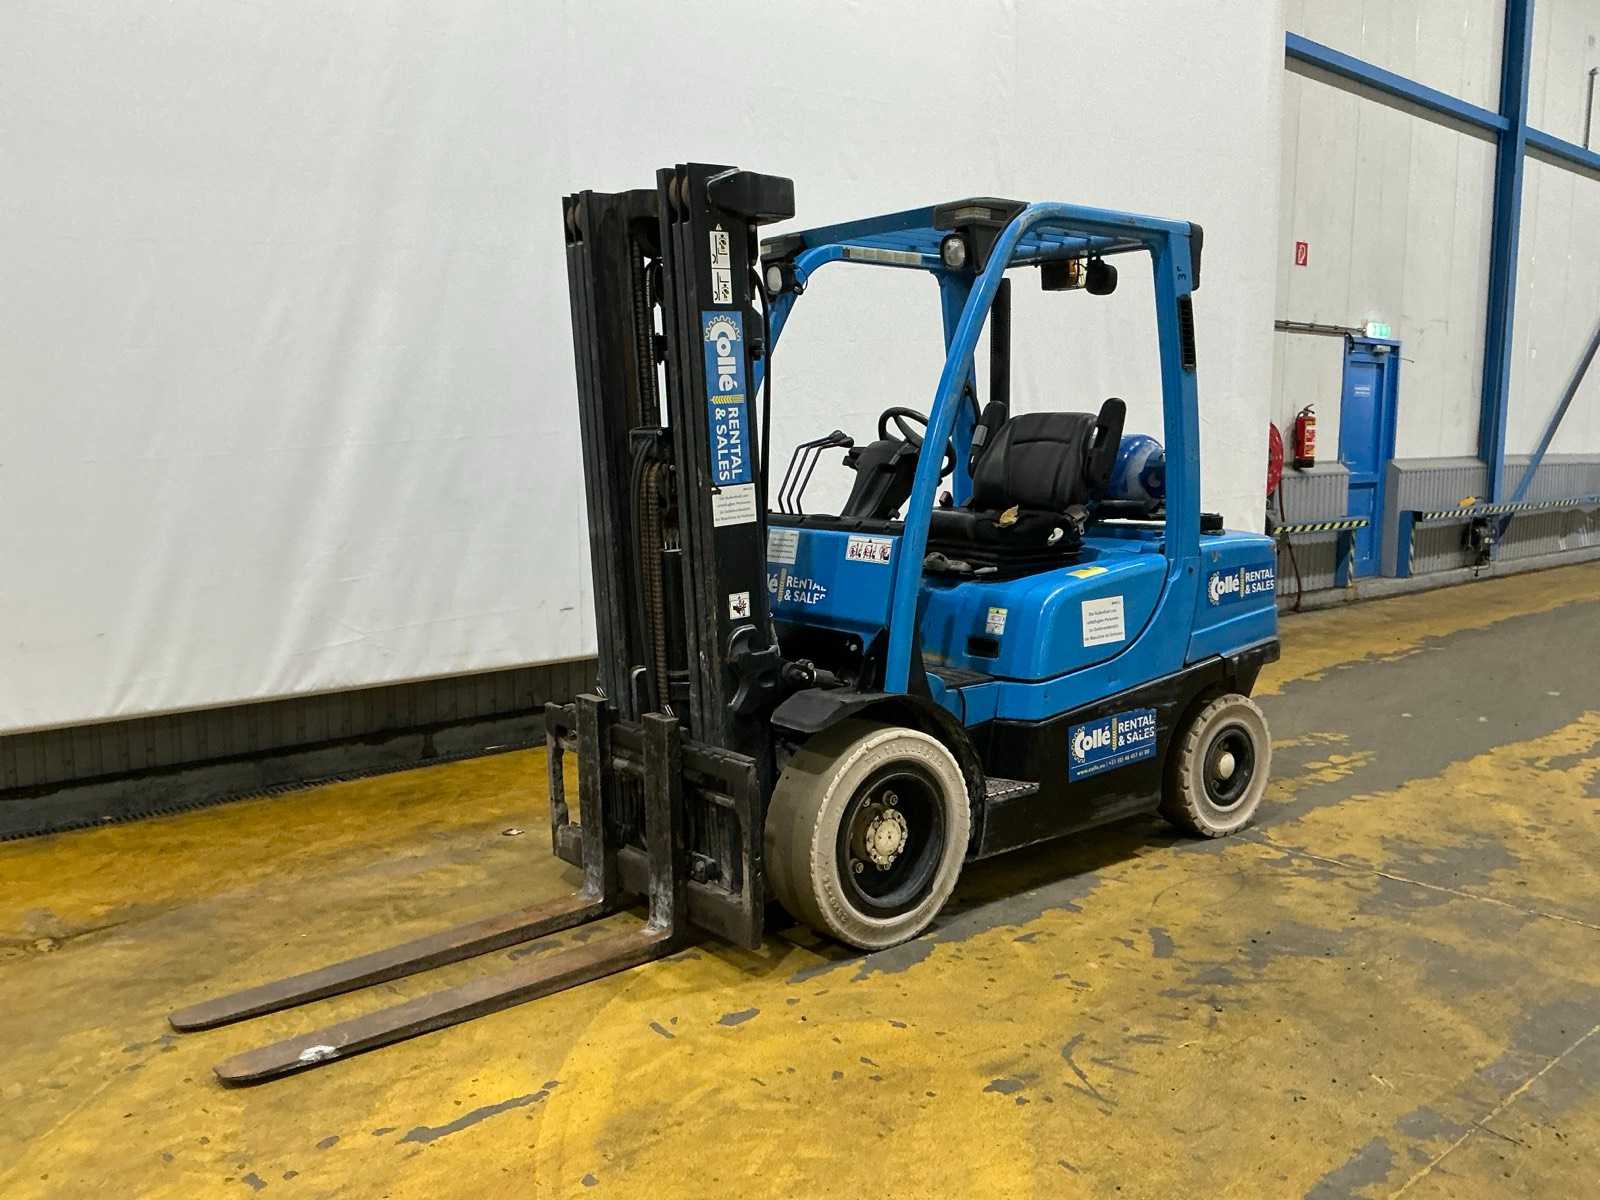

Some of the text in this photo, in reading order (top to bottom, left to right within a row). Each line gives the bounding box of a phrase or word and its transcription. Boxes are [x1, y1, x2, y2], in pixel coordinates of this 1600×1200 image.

[707, 318, 739, 392] Collé
[715, 408, 730, 481] & SALES
[728, 407, 742, 480] RENTAL
[1209, 573, 1240, 602] Collé
[1245, 568, 1275, 583] RENTAL
[1245, 579, 1275, 594] & SALES
[784, 589, 792, 601] &
[1118, 714, 1156, 733] RENTAL
[1072, 725, 1111, 760] Collé
[1118, 726, 1155, 747] & SALES
